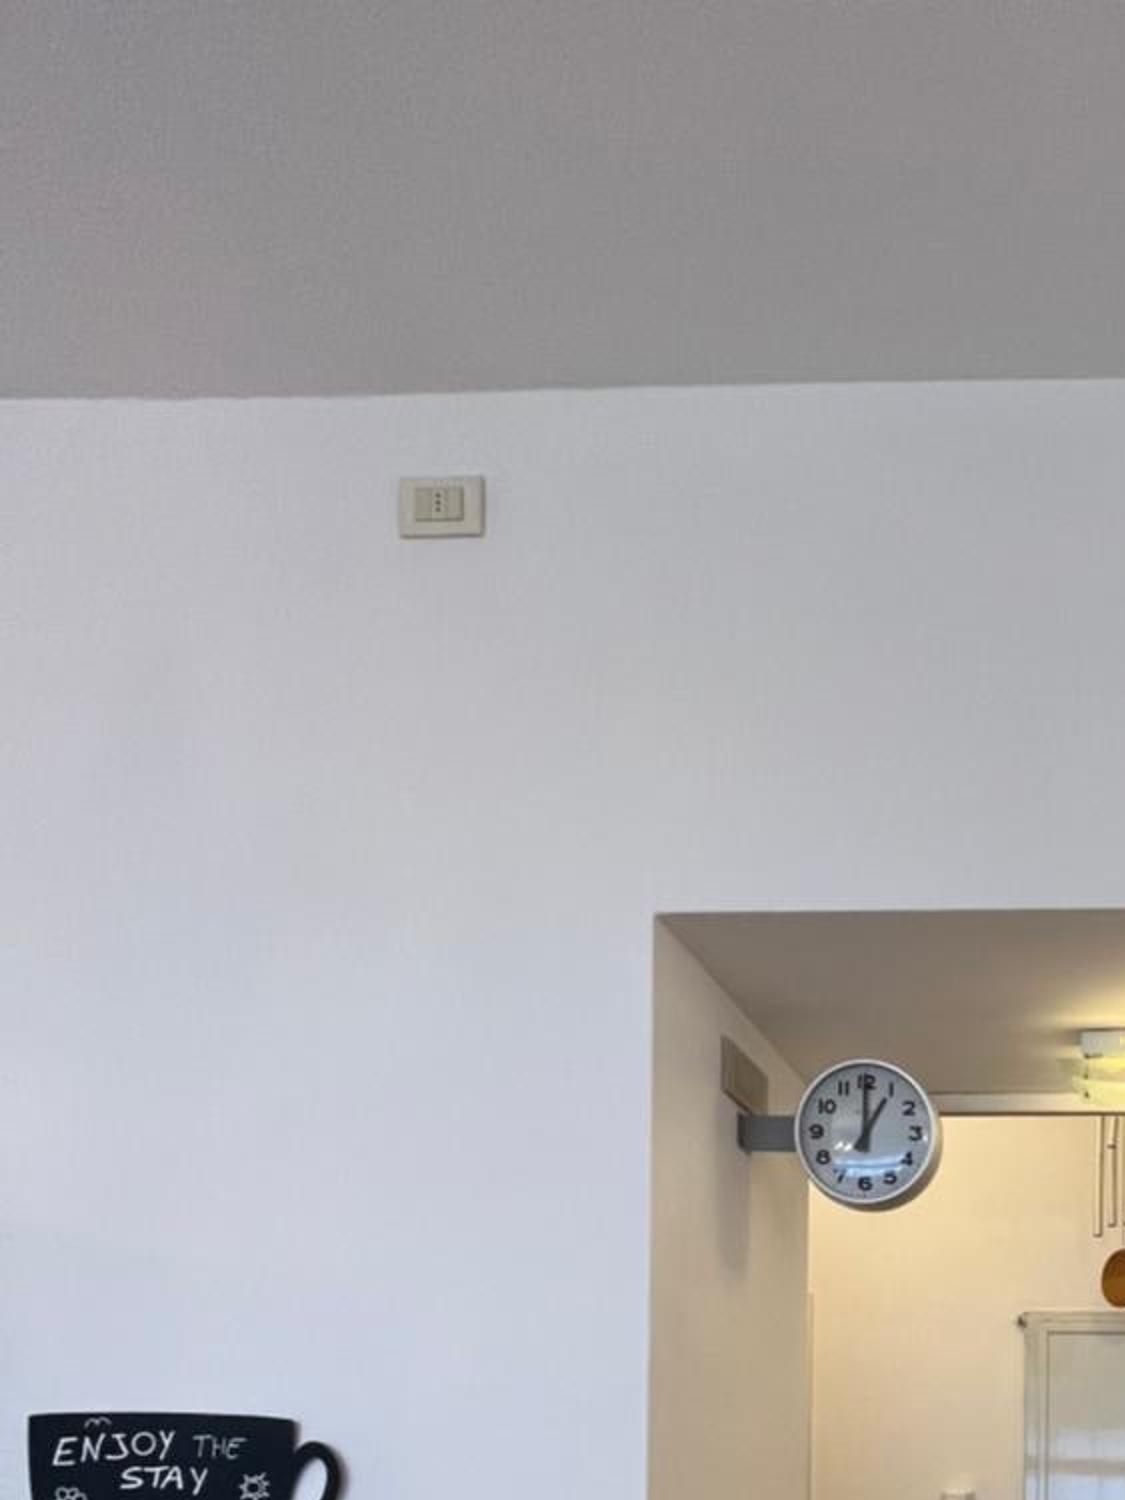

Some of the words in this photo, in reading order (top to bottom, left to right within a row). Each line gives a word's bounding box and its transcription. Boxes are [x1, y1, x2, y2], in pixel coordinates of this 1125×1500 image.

[838, 1080, 850, 1096] 11
[889, 1082, 894, 1097] 1
[818, 1098, 836, 1114] 10
[902, 1101, 916, 1116] 2
[809, 1124, 824, 1139] 9
[909, 1126, 922, 1141] 3
[816, 1150, 830, 1165] 8
[901, 1152, 913, 1165] 4
[833, 1168, 846, 1183] 7
[884, 1171, 897, 1185] 5
[858, 1177, 872, 1191] 6
[52, 1430, 175, 1467] ENJOY
[192, 1434, 248, 1459] THE
[120, 1465, 208, 1496] STAY
